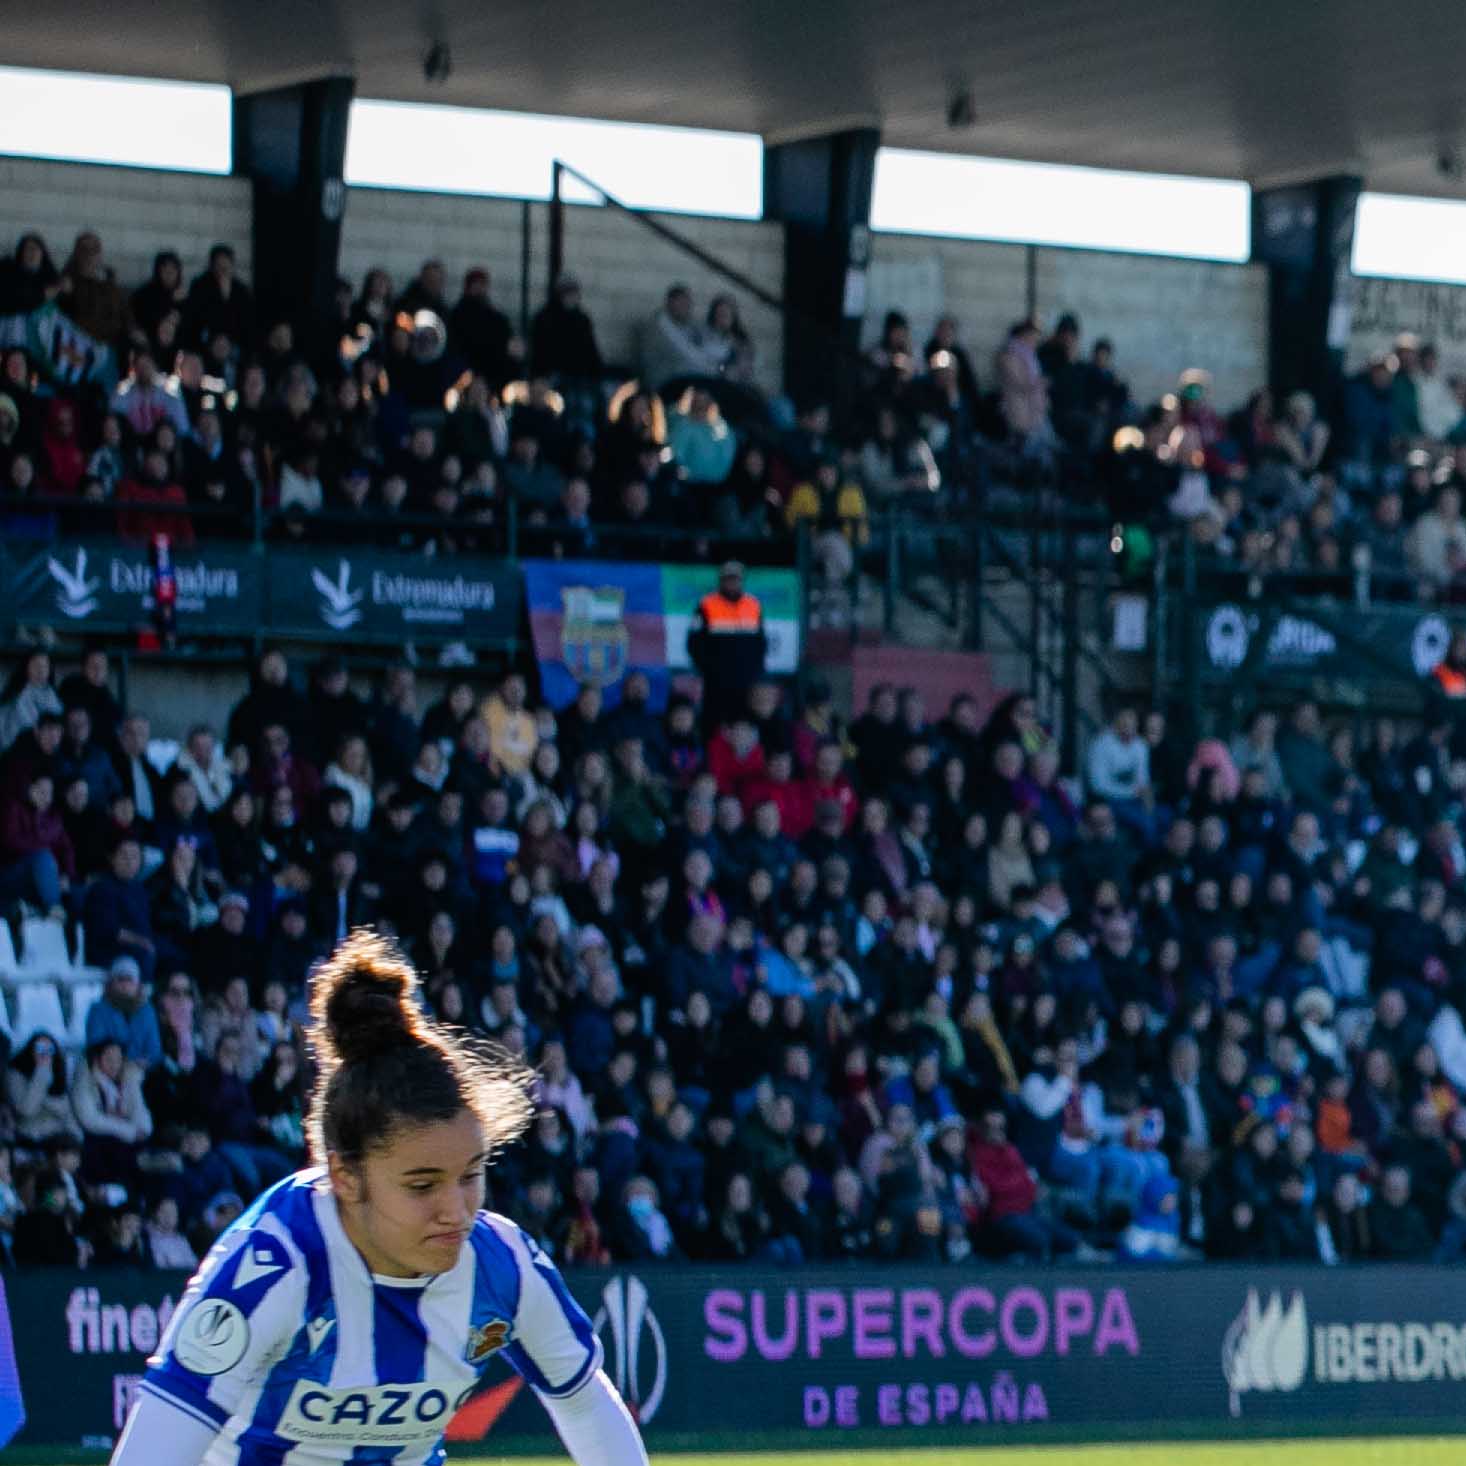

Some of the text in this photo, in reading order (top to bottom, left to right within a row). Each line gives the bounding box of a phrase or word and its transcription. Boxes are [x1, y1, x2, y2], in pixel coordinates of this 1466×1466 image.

[372, 570, 494, 609] Extremadura
[703, 1287, 1140, 1361] SUPERCOPA
[803, 1371, 1049, 1428] DE ESPAÑA
